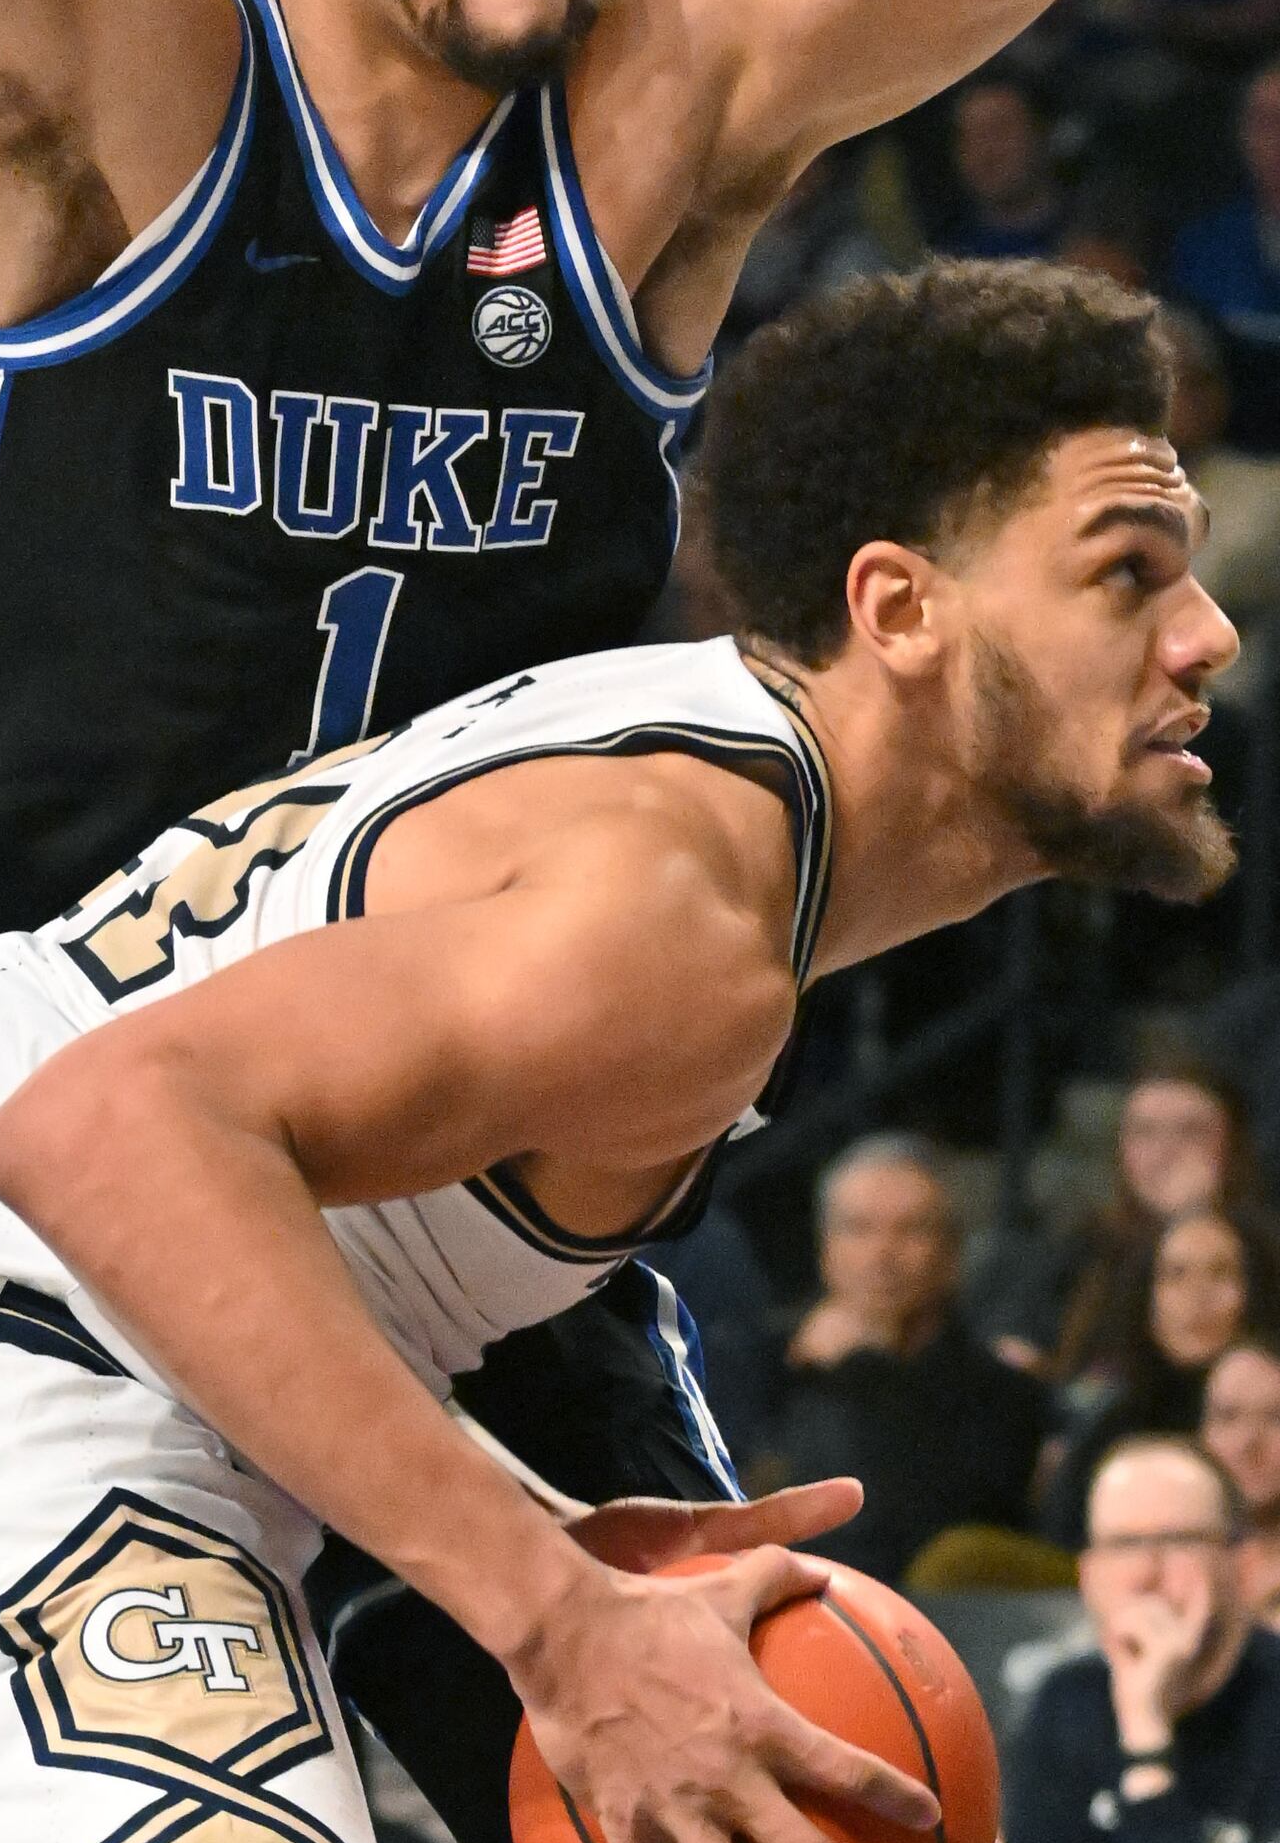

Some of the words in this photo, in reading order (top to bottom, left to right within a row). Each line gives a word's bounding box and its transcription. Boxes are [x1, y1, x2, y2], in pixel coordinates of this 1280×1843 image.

[485, 310, 543, 333] ACC
[168, 368, 586, 553] DUKE
[286, 565, 405, 767] 1
[80, 1585, 263, 1693] GT
